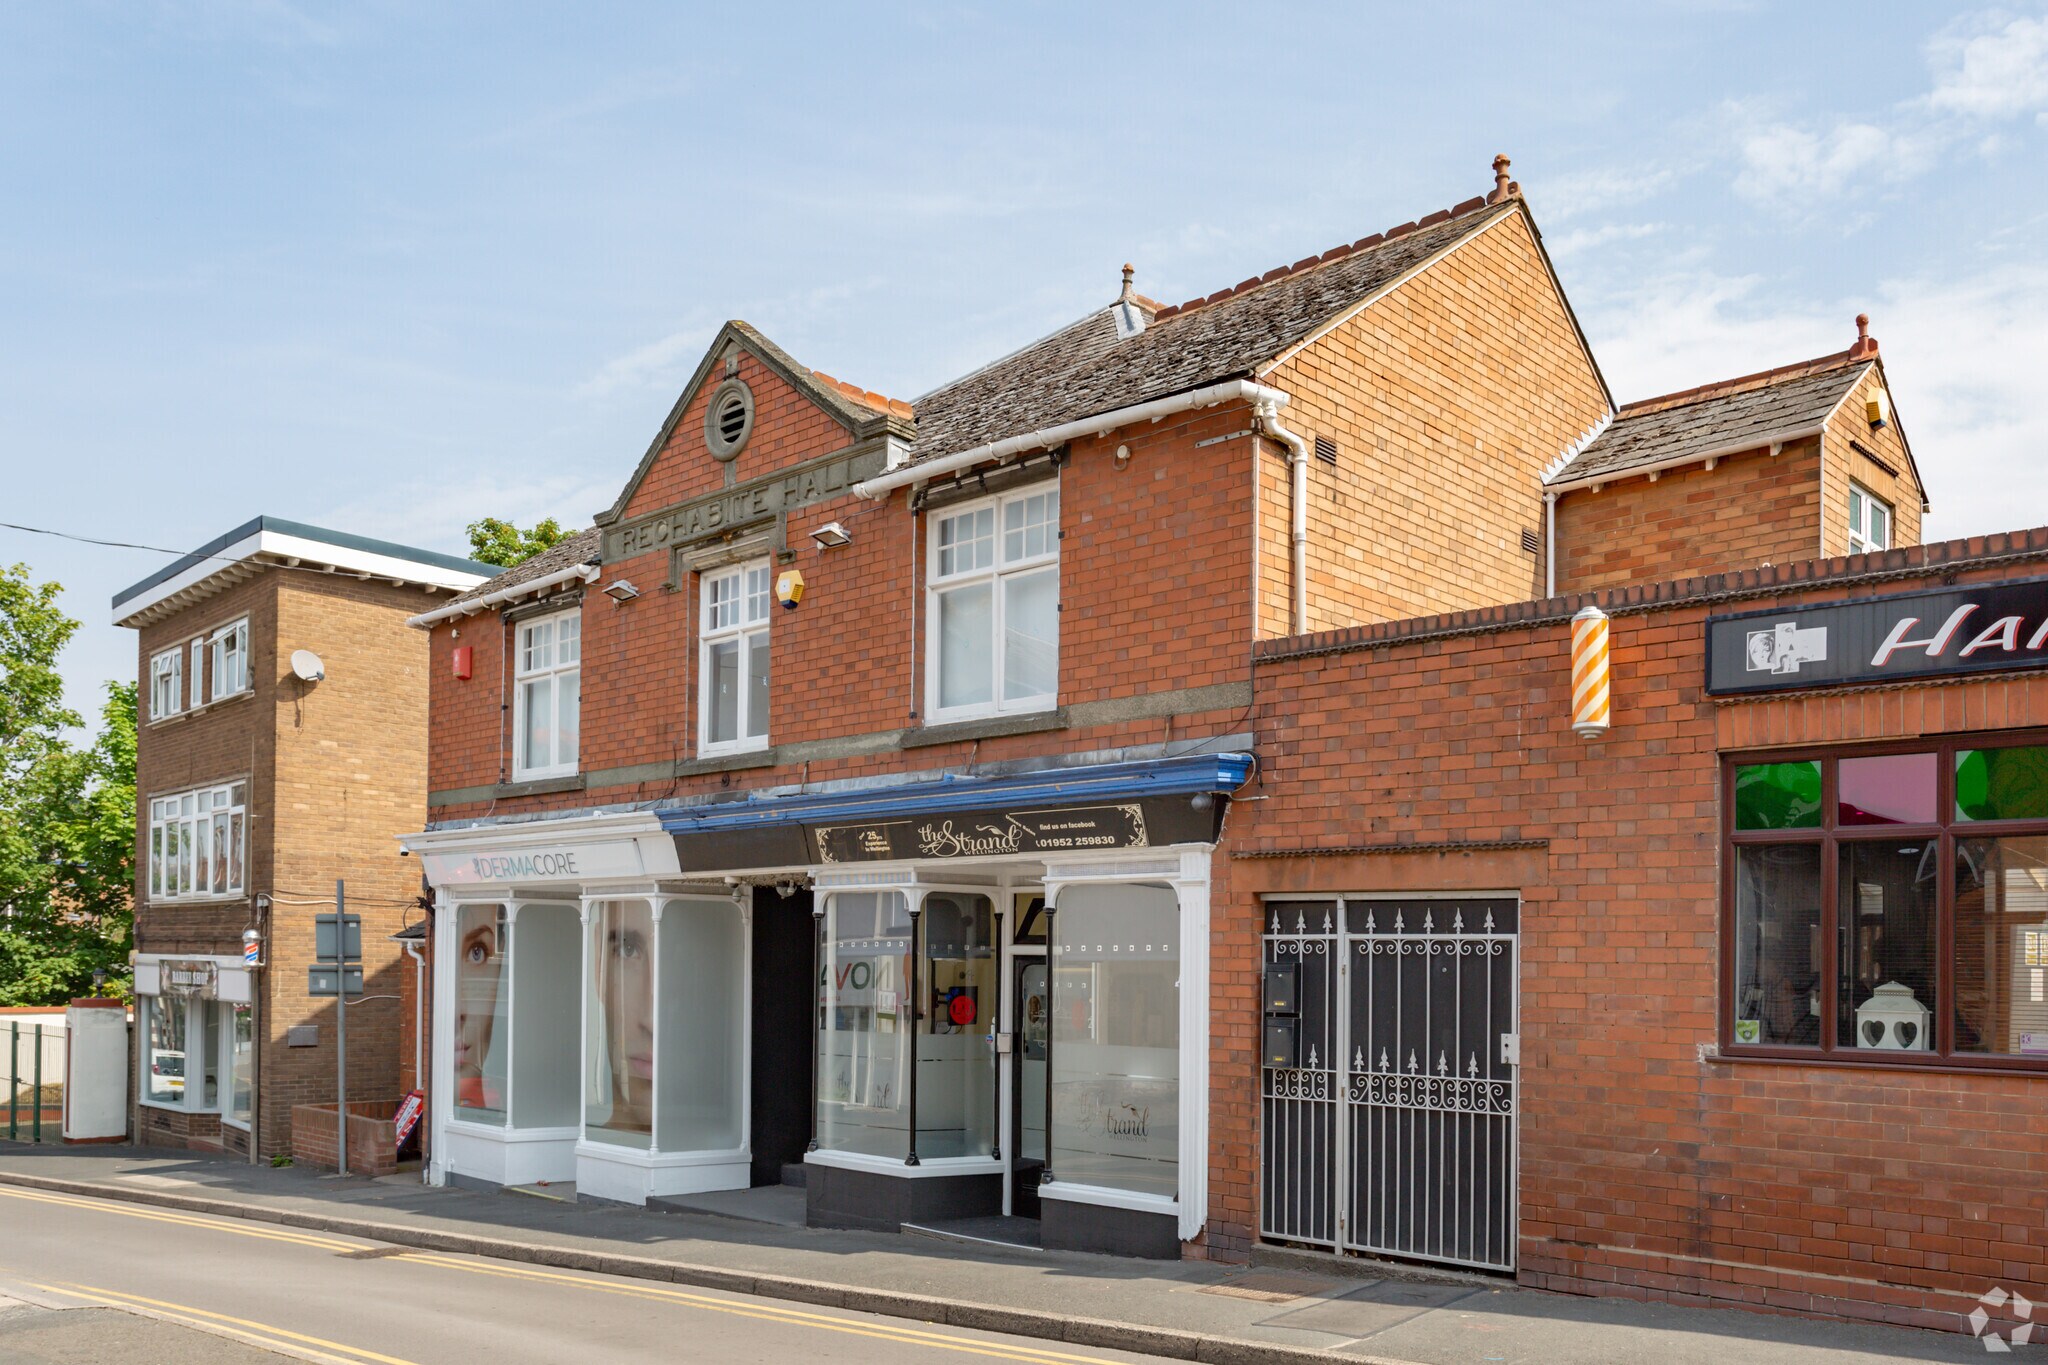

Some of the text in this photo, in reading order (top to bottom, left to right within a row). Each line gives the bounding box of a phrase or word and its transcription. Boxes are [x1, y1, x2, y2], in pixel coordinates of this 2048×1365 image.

[622, 461, 865, 553] RECHABITE HALL
[918, 820, 1022, 857] the Strand
[964, 847, 1019, 856] WELLINGTON
[1040, 835, 1116, 848] 01952 259830
[480, 852, 579, 878] DERMACORE
